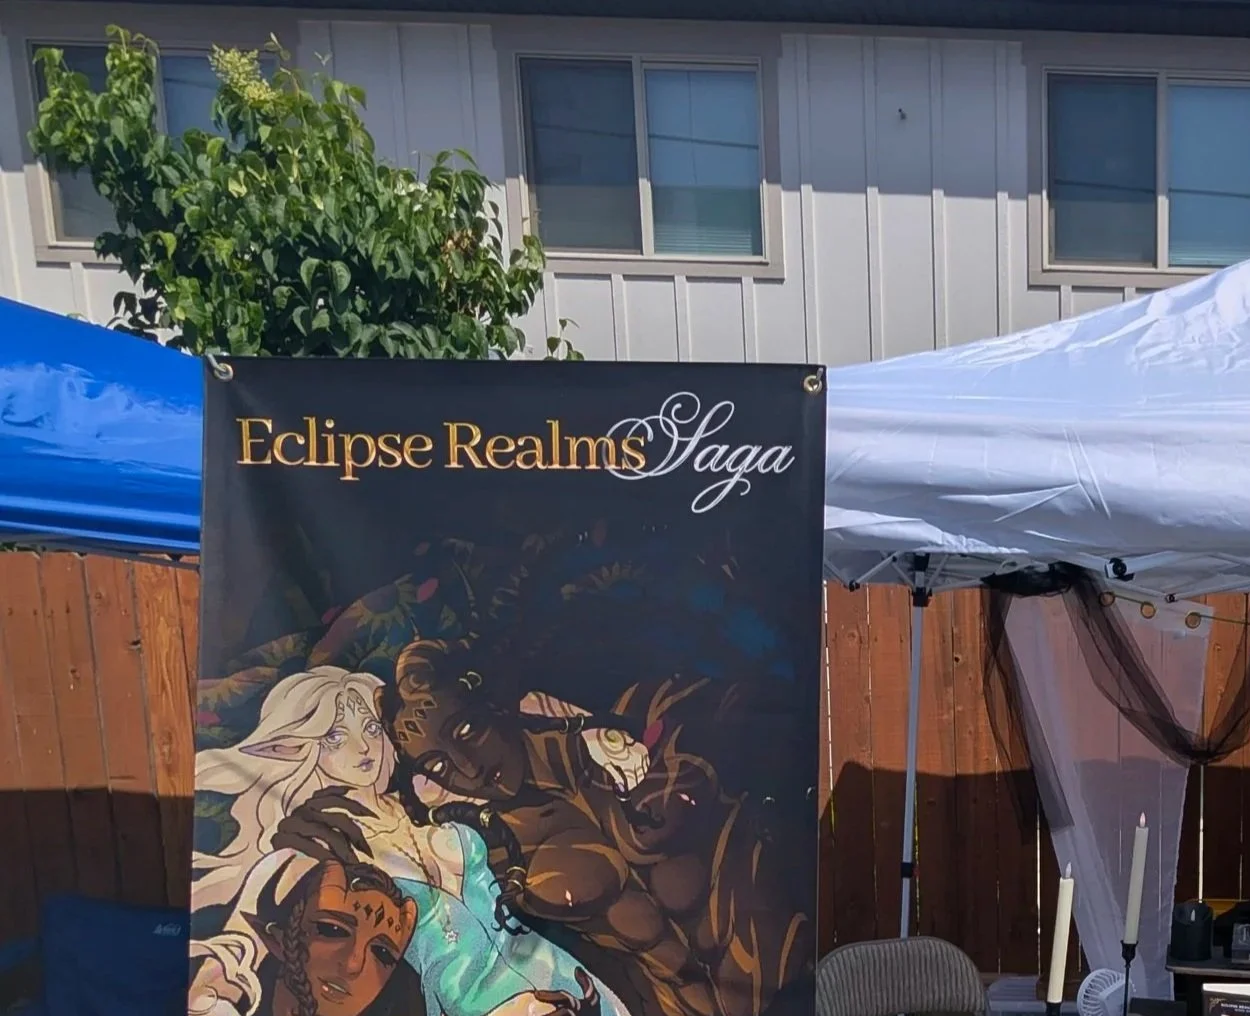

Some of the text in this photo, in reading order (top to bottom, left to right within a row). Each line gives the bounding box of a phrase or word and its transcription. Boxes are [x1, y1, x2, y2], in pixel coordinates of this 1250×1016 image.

[236, 391, 796, 513] Eclipse Realms Saga
